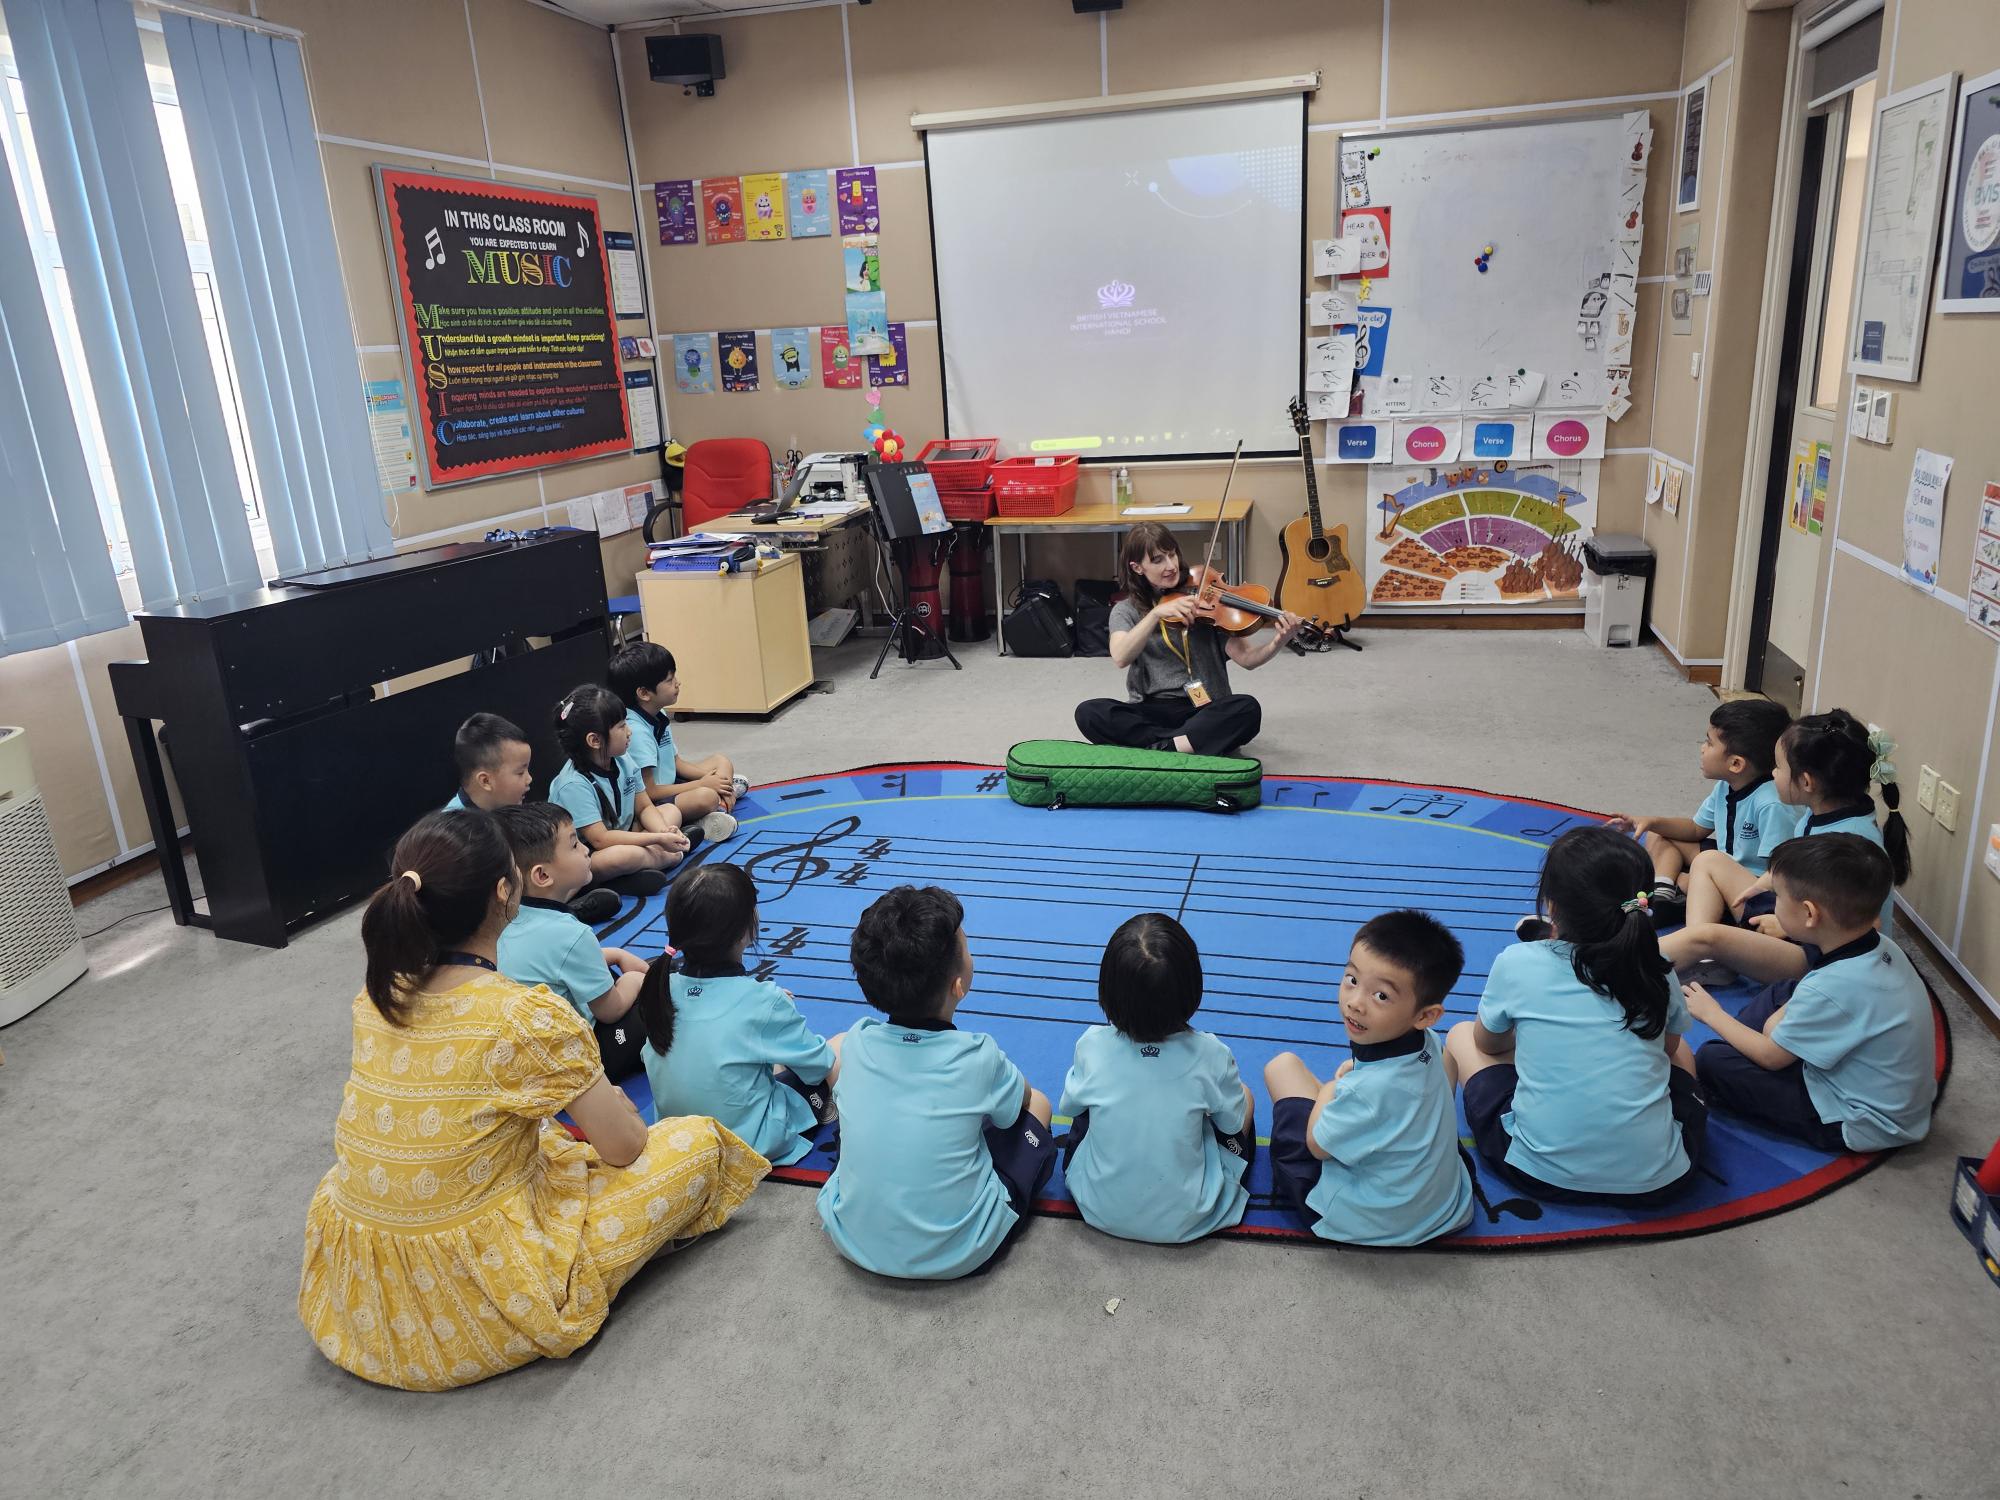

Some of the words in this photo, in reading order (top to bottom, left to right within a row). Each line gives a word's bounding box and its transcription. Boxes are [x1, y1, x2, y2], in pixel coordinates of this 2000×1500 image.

[444, 209, 460, 228] IN
[460, 211, 491, 230] THIS
[493, 214, 532, 234] CLASS
[532, 218, 567, 237] ROOM
[1346, 222, 1365, 230] HEAR
[469, 236, 484, 247] YOU
[484, 238, 498, 247] ARE
[499, 239, 528, 250] EXPECTED
[528, 241, 538, 250] TO
[538, 241, 557, 251] LEARN
[461, 250, 573, 288] MUSIC
[1370, 314, 1384, 322] clef
[1347, 439, 1368, 447] Verse
[1412, 441, 1439, 449] Chorus
[1483, 437, 1504, 445] Verse
